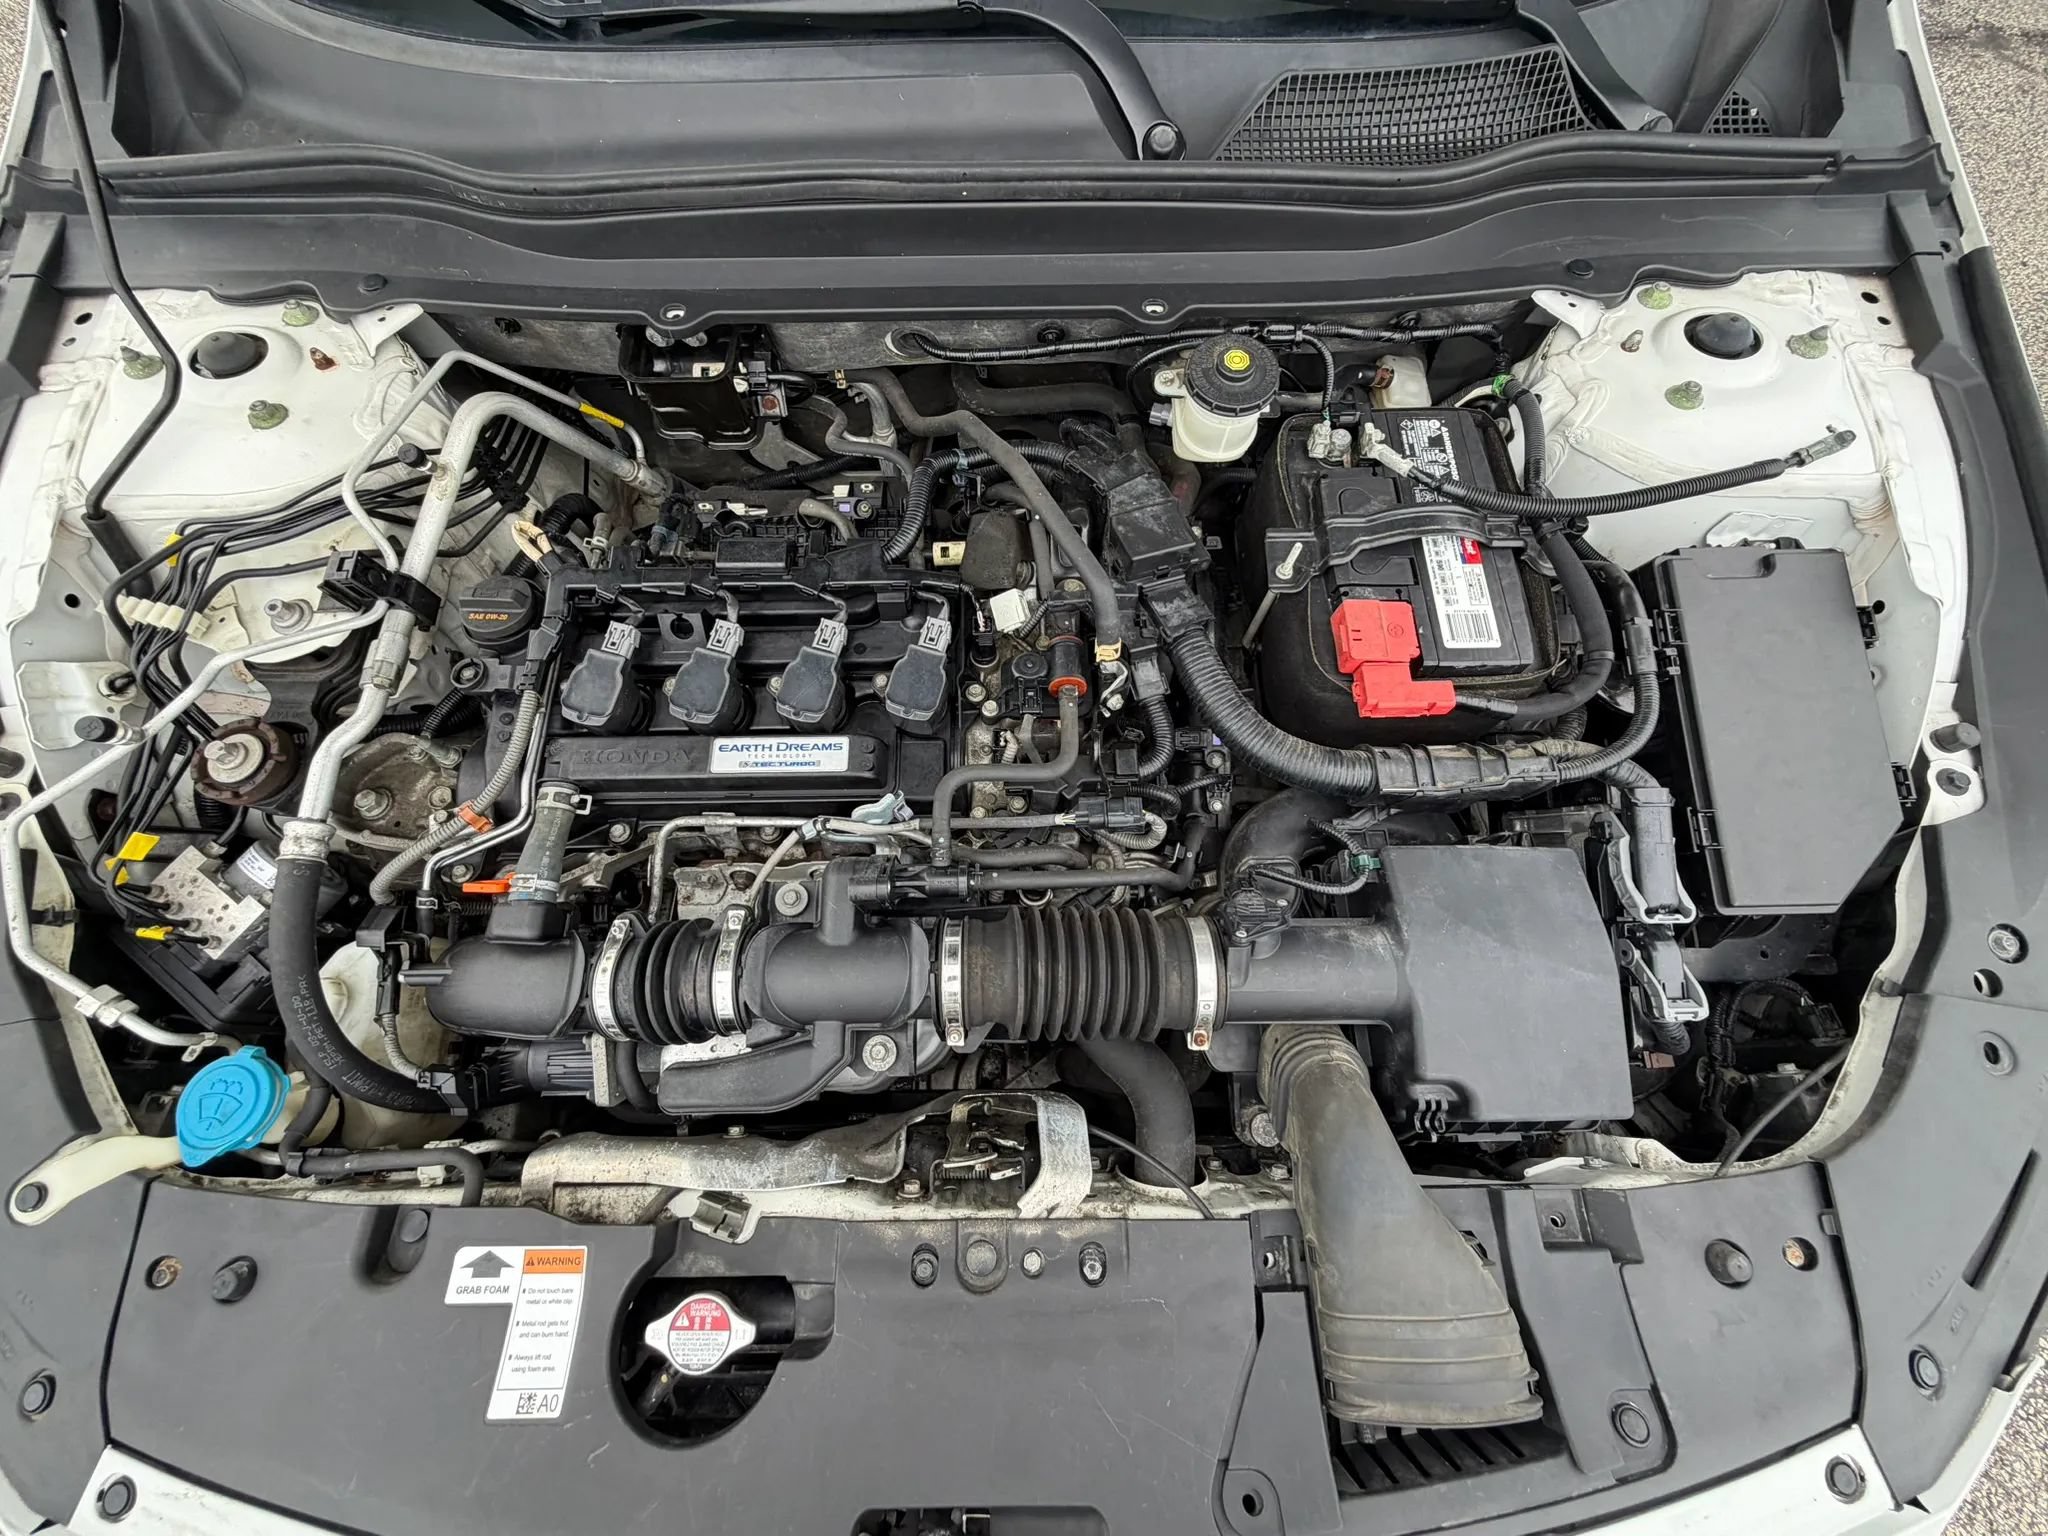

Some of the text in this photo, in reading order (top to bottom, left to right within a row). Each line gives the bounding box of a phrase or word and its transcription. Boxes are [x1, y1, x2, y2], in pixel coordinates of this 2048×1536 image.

[468, 612, 485, 621] SAE
[718, 742, 844, 753] EARTH DREAMS
[575, 748, 693, 765] HONDA
[536, 1256, 582, 1266] WARNING
[456, 1285, 510, 1295] GRAB FOAM
[547, 1320, 559, 1328] gets
[513, 1354, 533, 1362] Always
[511, 1366, 526, 1374] using
